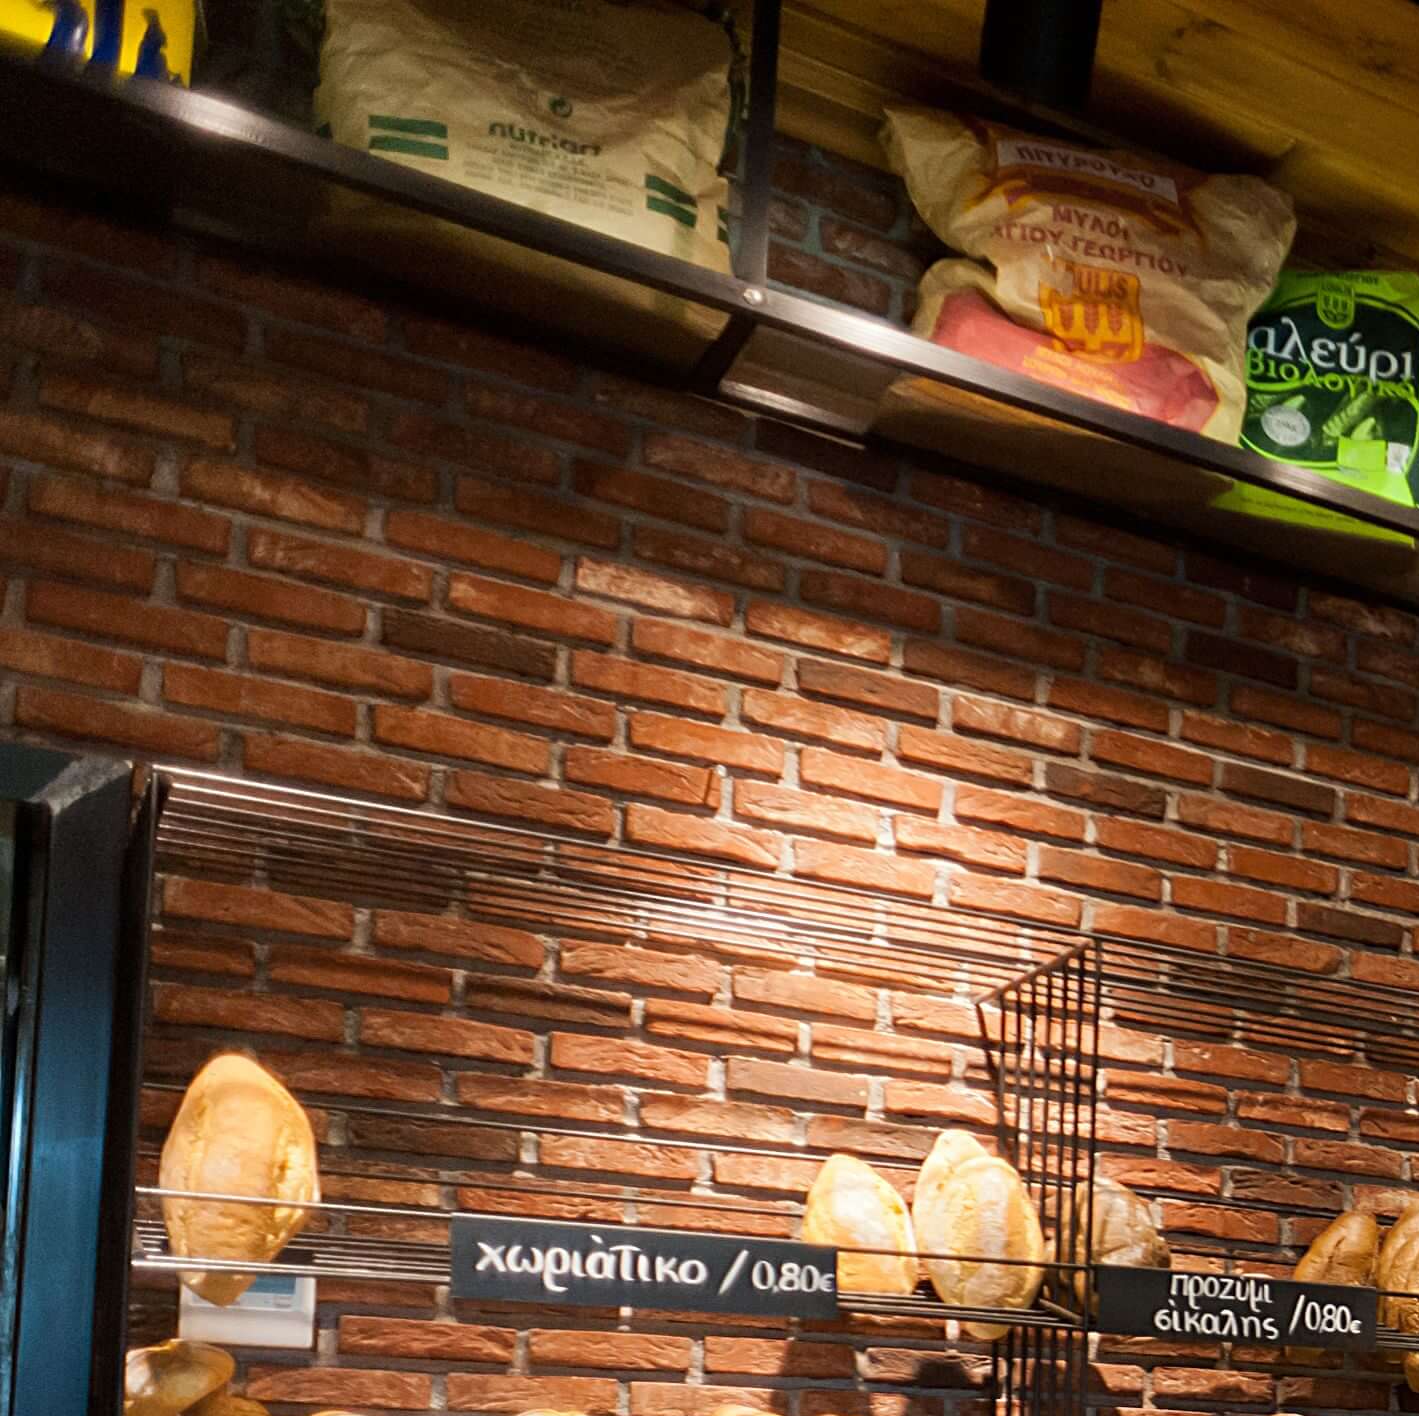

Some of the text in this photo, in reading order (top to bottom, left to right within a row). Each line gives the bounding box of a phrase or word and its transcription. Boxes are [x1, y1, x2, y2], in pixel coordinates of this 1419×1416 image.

[1247, 315, 1416, 387] αλεύρι
[474, 1234, 708, 1293] χωριάτικο
[1169, 1273, 1274, 1313] προζύμι
[1153, 1299, 1280, 1341] σίκαλης
